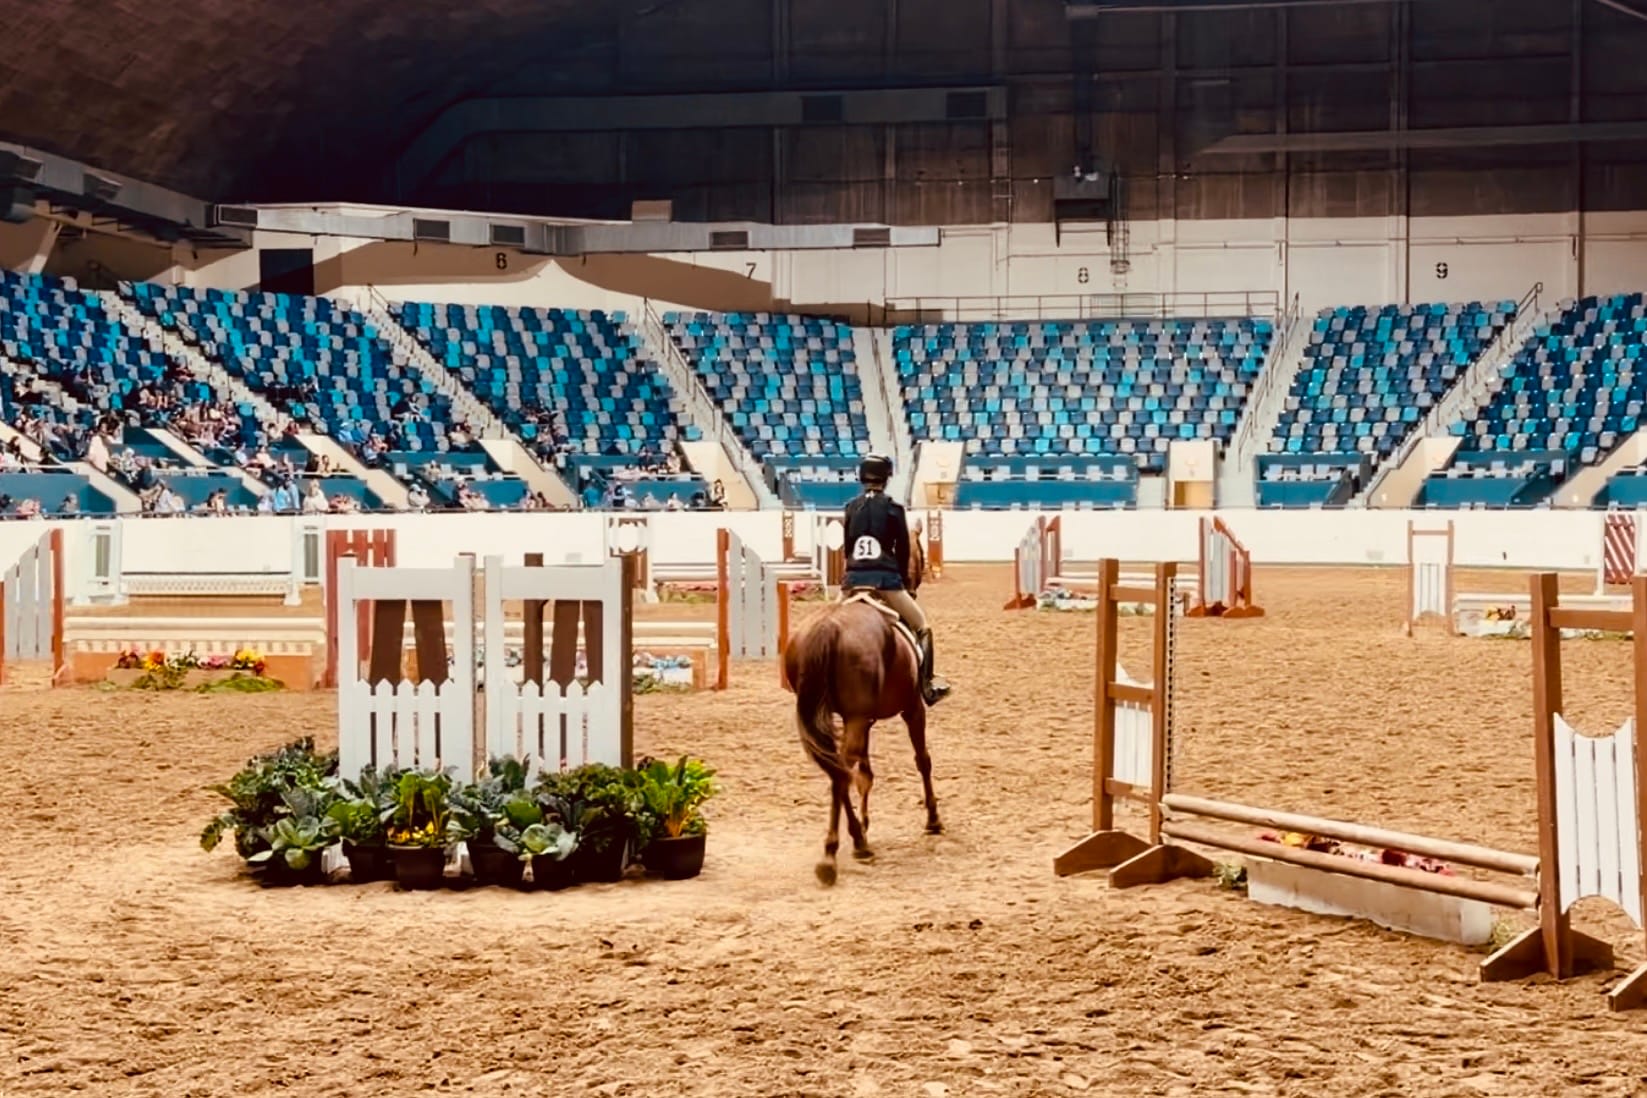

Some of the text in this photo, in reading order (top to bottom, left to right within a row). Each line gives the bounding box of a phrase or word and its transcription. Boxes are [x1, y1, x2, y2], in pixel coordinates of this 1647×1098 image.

[746, 262, 757, 279] 7
[1078, 267, 1089, 283] 8
[1437, 262, 1448, 279] 9
[858, 540, 873, 556] 51
